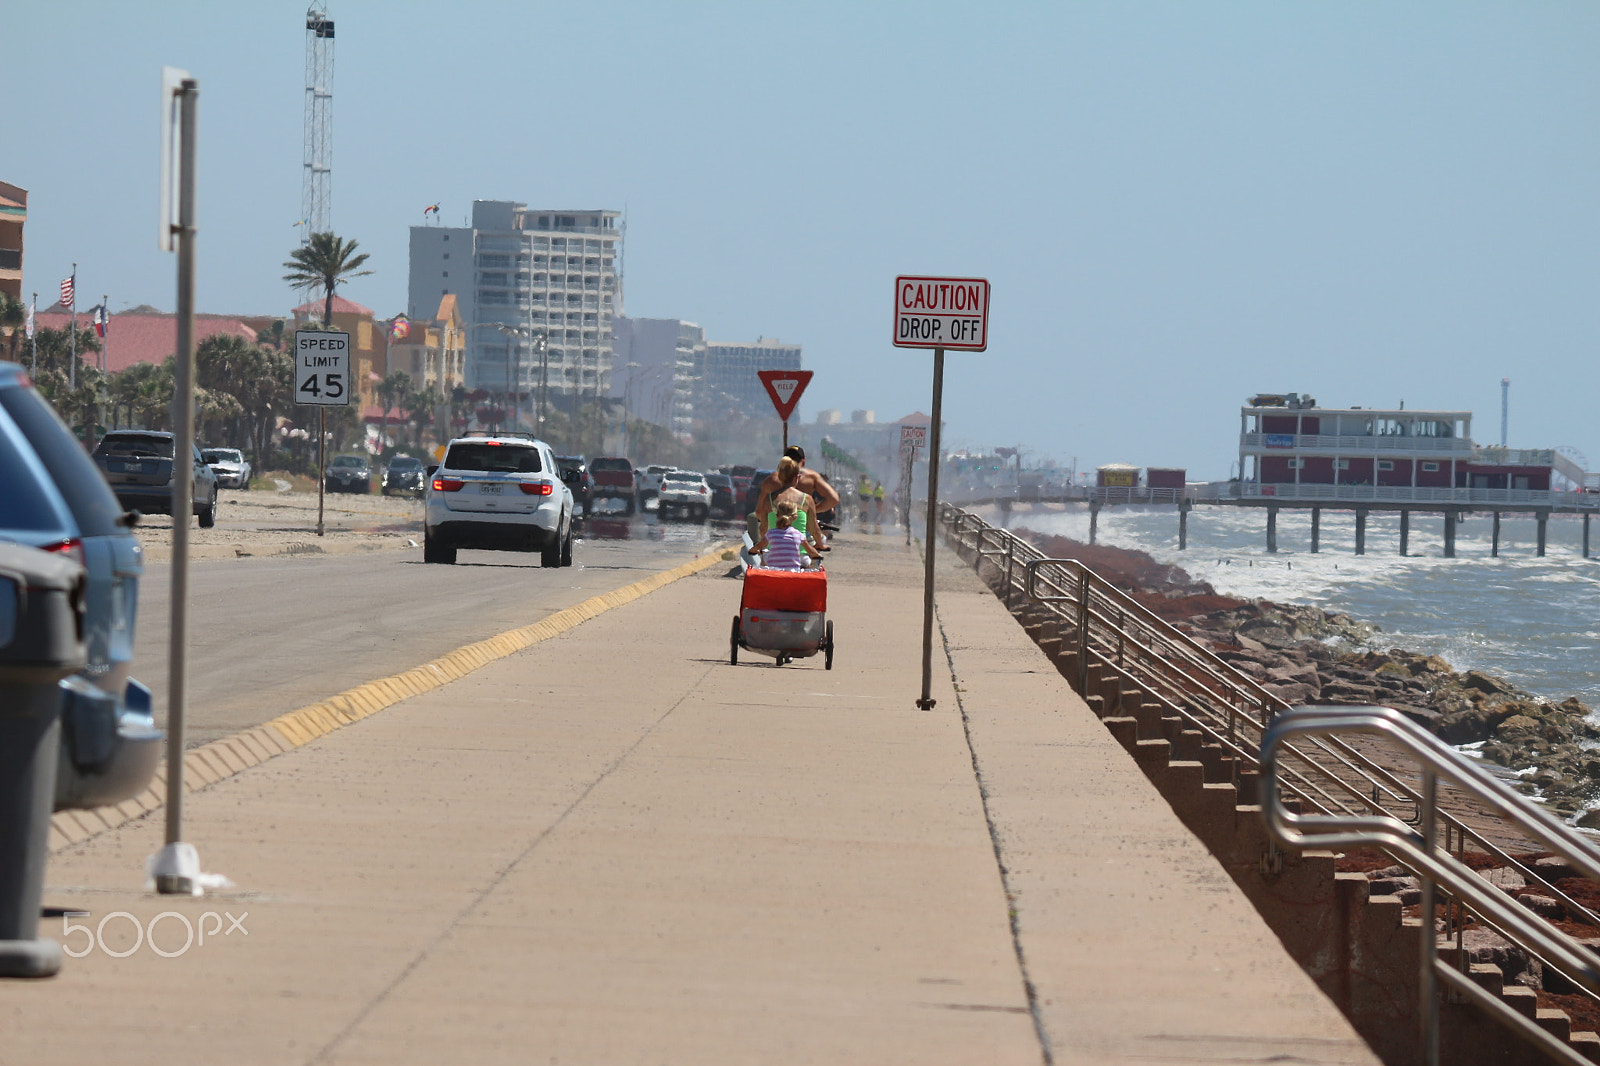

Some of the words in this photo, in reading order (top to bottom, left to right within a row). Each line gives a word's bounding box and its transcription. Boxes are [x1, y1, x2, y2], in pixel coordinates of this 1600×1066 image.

[902, 283, 980, 311] CAUTION
[900, 317, 942, 339] DROP
[951, 319, 980, 341] OFF
[300, 338, 345, 350] SPEED
[304, 356, 340, 367] LIMIT
[300, 373, 344, 398] 45
